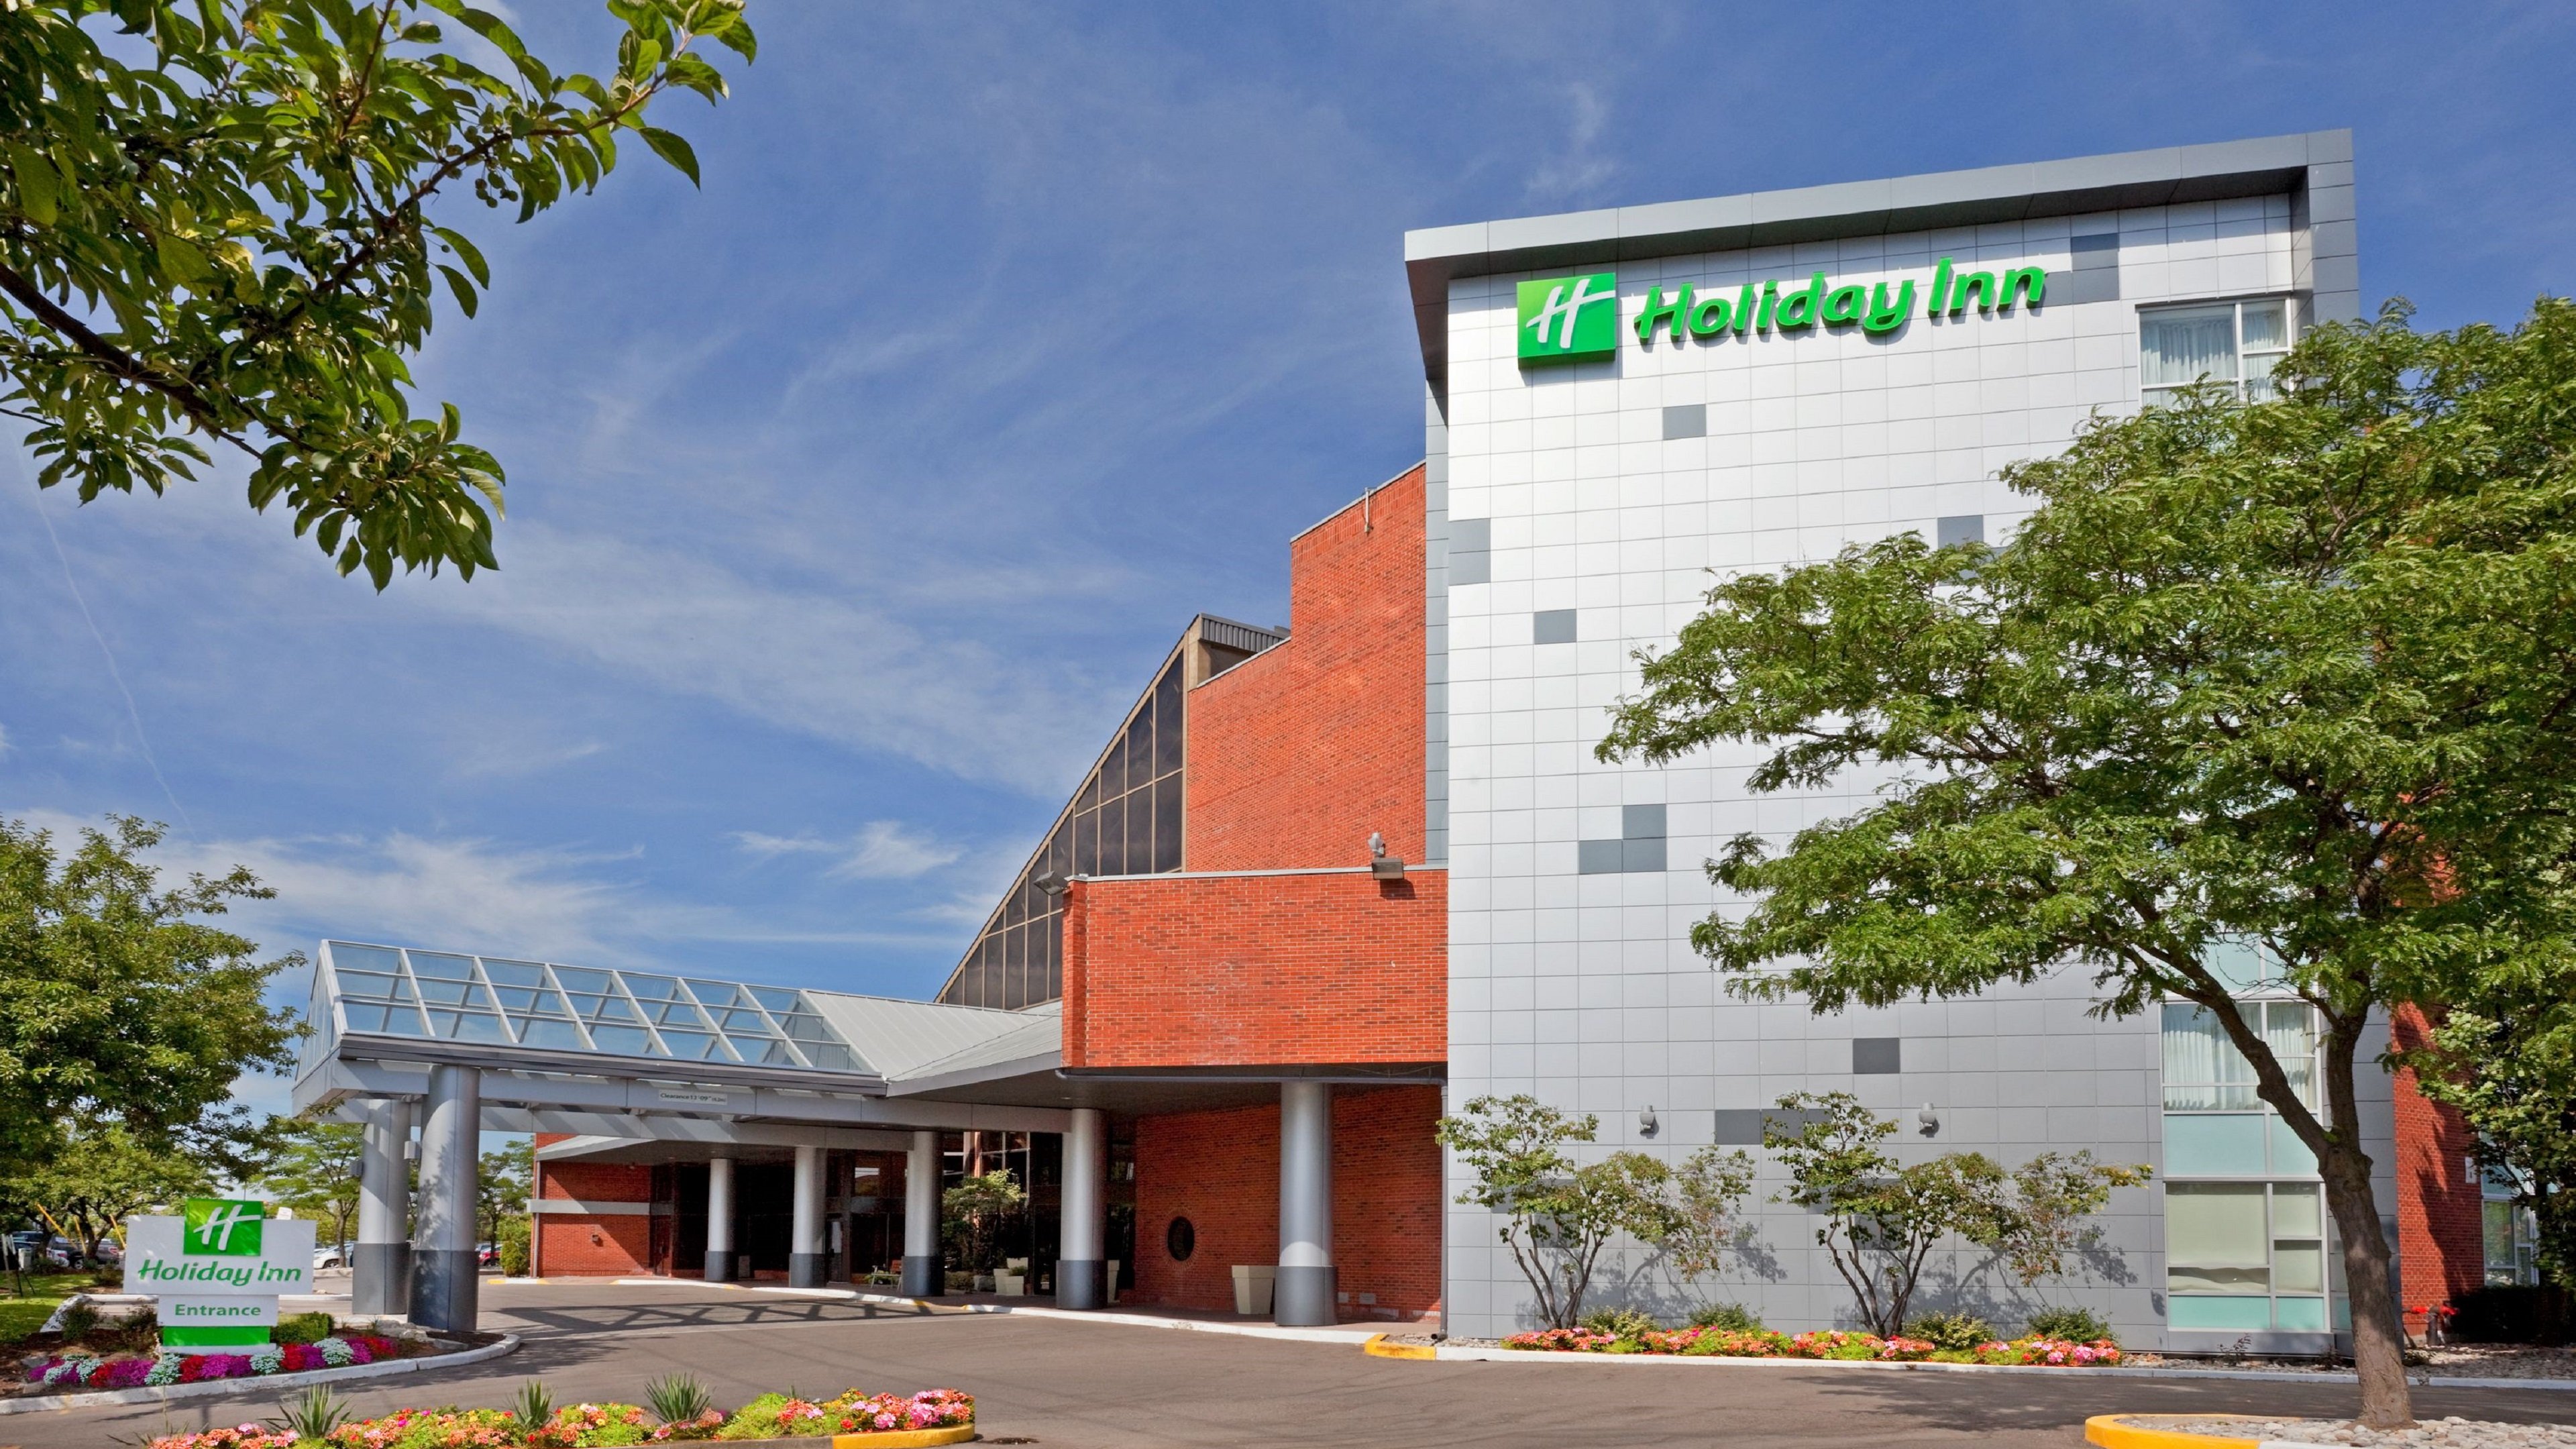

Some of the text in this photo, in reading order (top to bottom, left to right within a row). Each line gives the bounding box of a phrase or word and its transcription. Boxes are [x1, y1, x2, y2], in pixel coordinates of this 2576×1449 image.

[1633, 256, 2045, 341] Holiday Inn
[138, 1259, 301, 1286] Holiday Inn
[174, 1304, 262, 1316] Entrance
